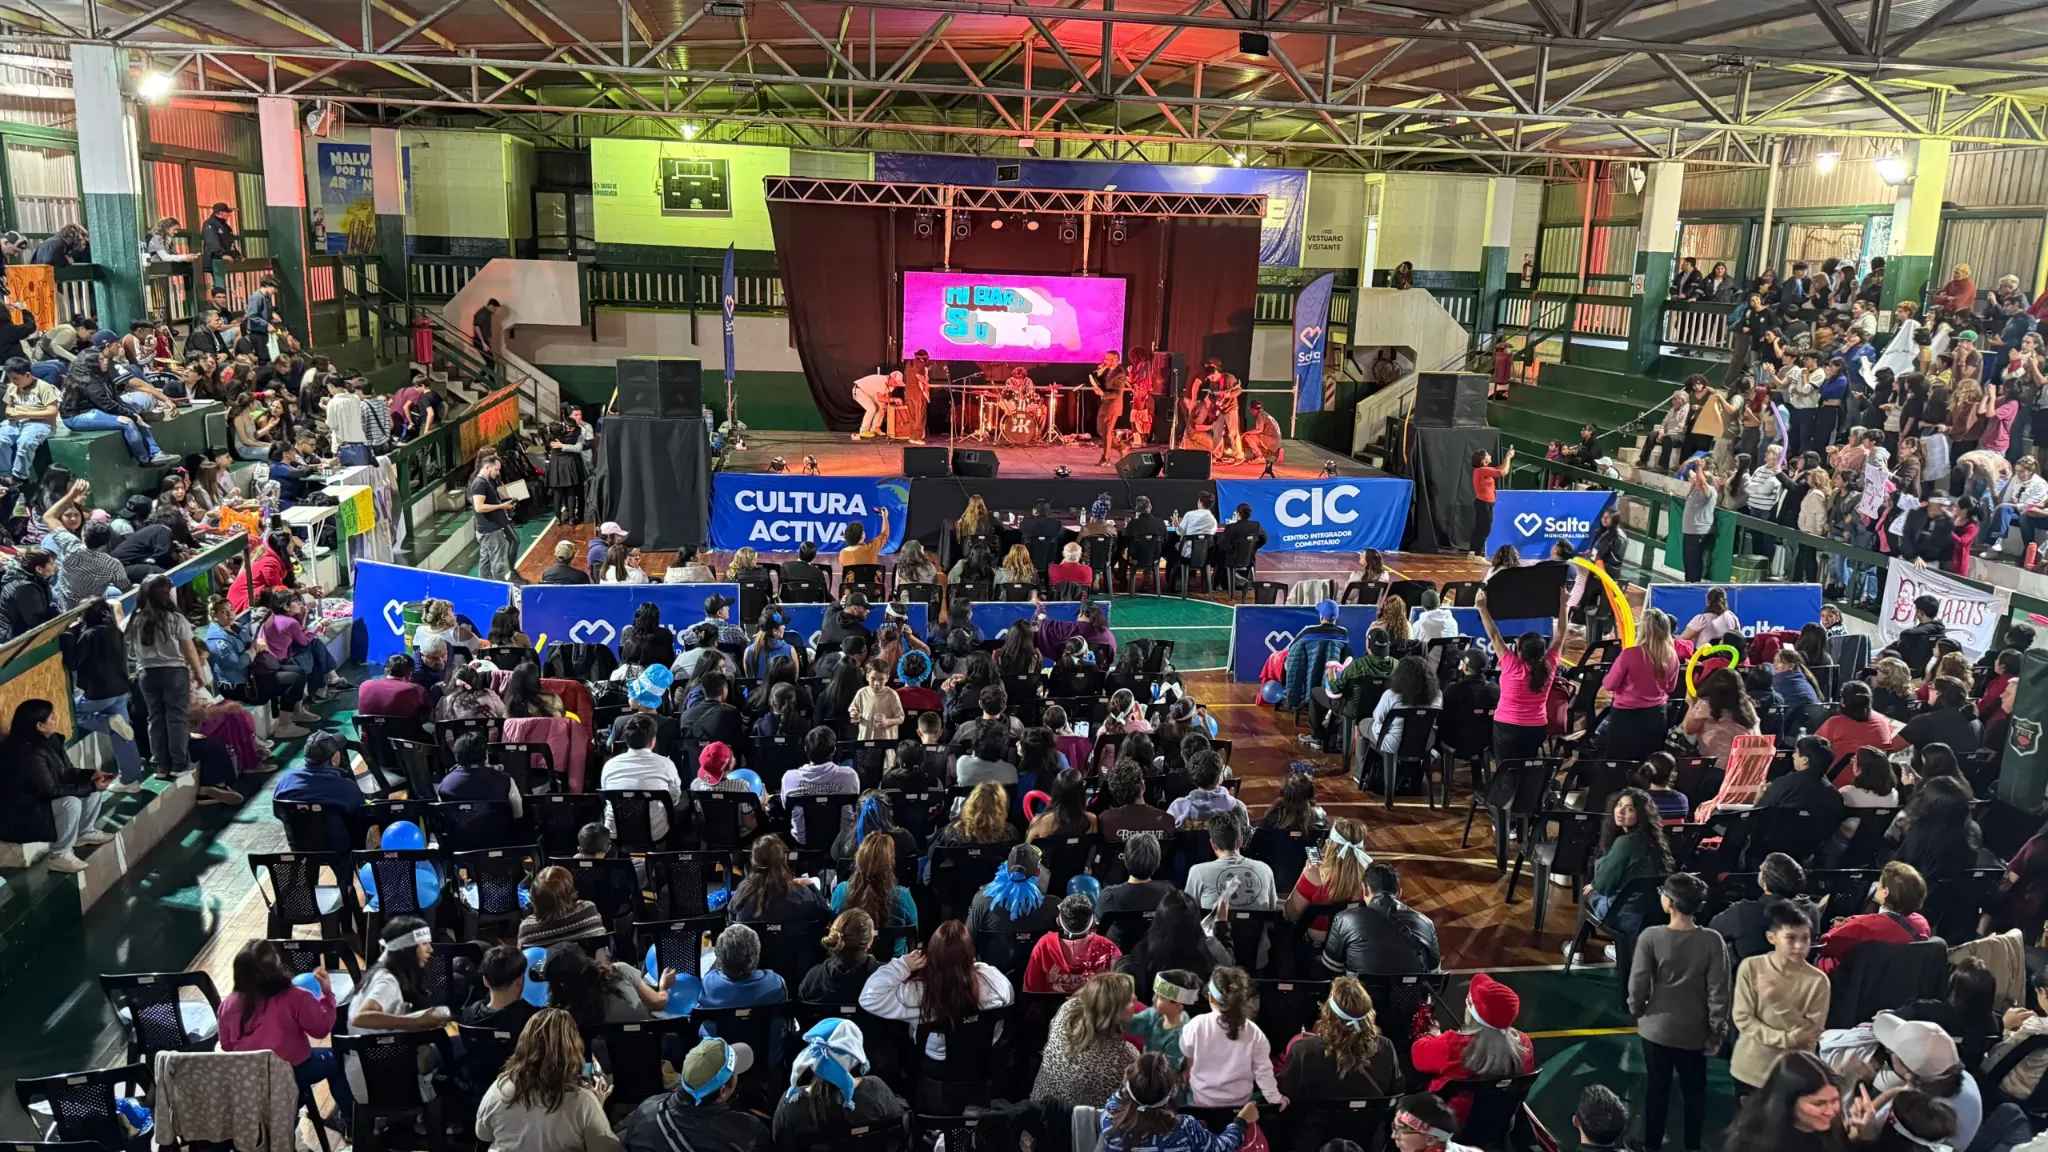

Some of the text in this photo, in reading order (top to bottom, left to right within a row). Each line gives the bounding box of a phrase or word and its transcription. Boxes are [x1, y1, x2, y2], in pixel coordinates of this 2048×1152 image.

[330, 151, 370, 166] MALV
[1307, 234, 1344, 242] VESTUARIO
[1308, 243, 1341, 251] VISITANTE
[735, 489, 868, 516] CULTURA
[1274, 484, 1361, 528] CIC
[1544, 517, 1590, 532] Salta
[1282, 530, 1353, 542] CENTRO INTEGRADOR
[1742, 620, 1786, 638] alta
